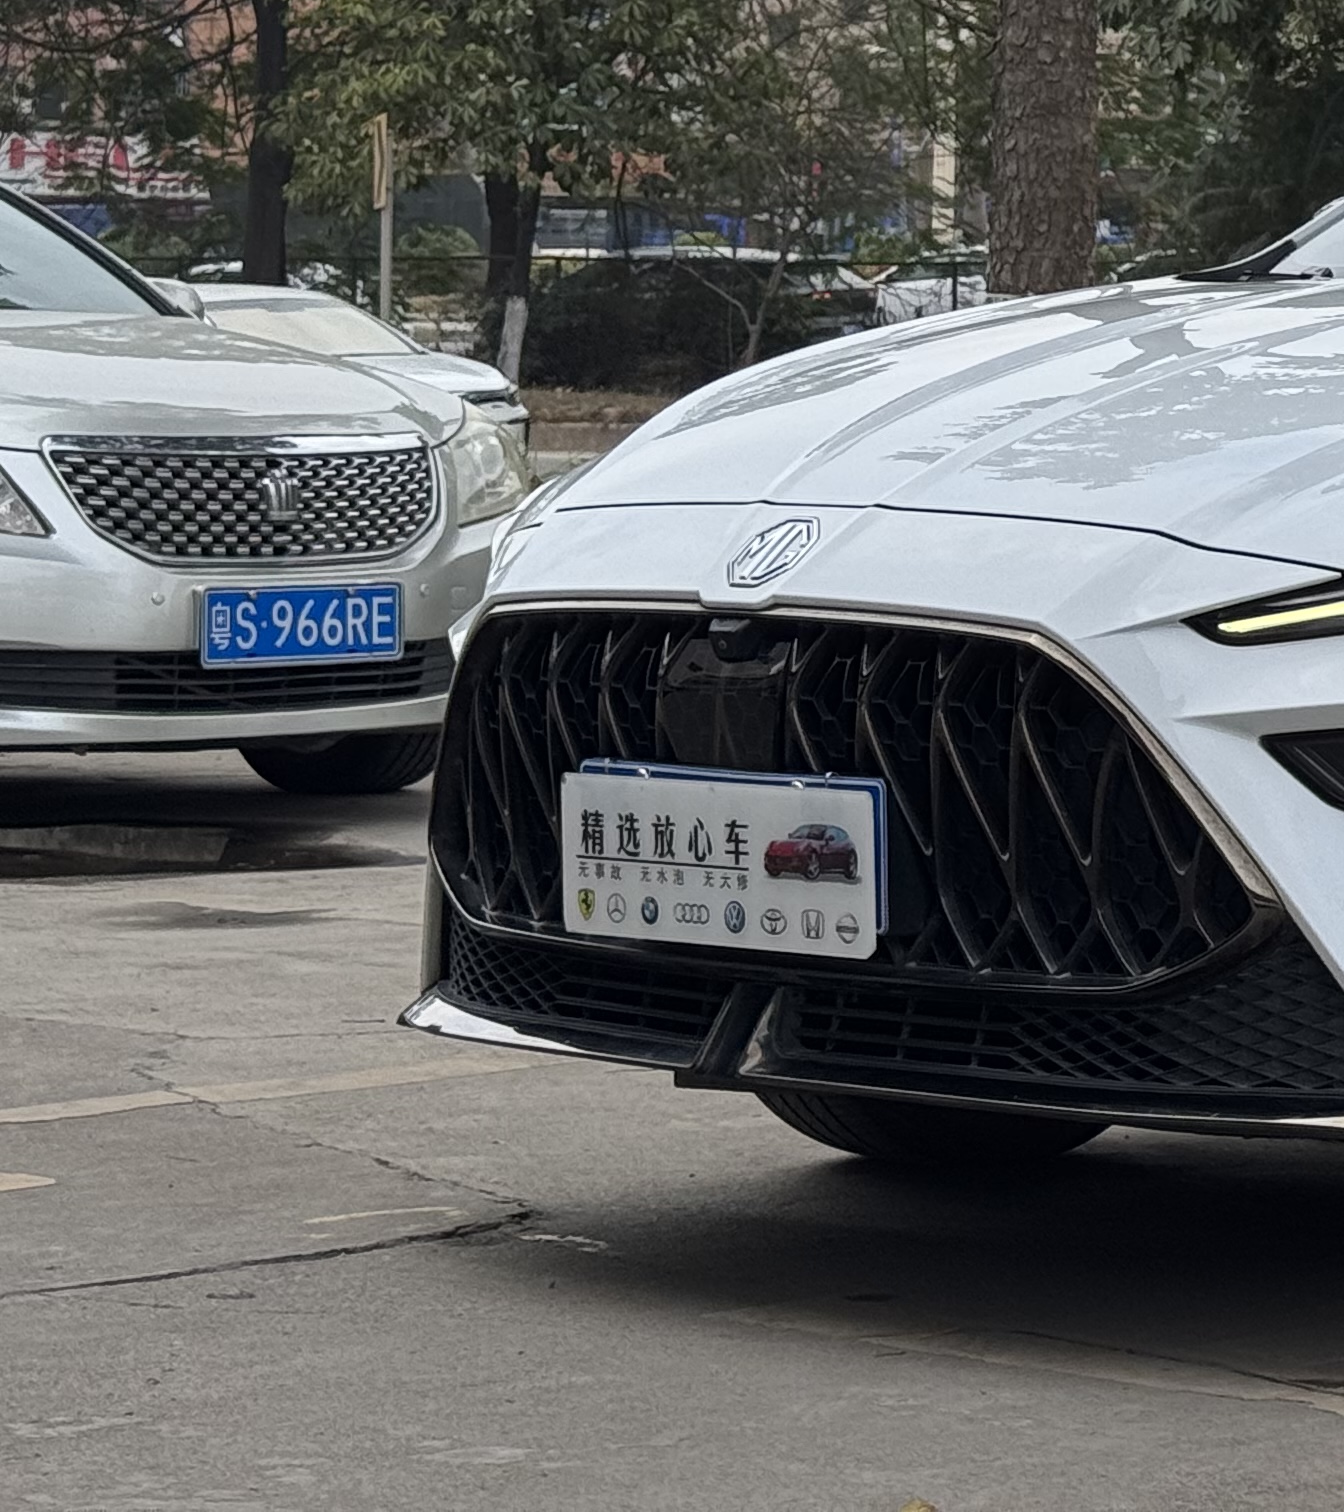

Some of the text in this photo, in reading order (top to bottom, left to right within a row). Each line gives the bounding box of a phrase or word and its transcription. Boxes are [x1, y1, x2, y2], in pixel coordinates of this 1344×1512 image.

[209, 595, 394, 651] 粤S·966RE
[579, 809, 750, 865] 精选放心车
